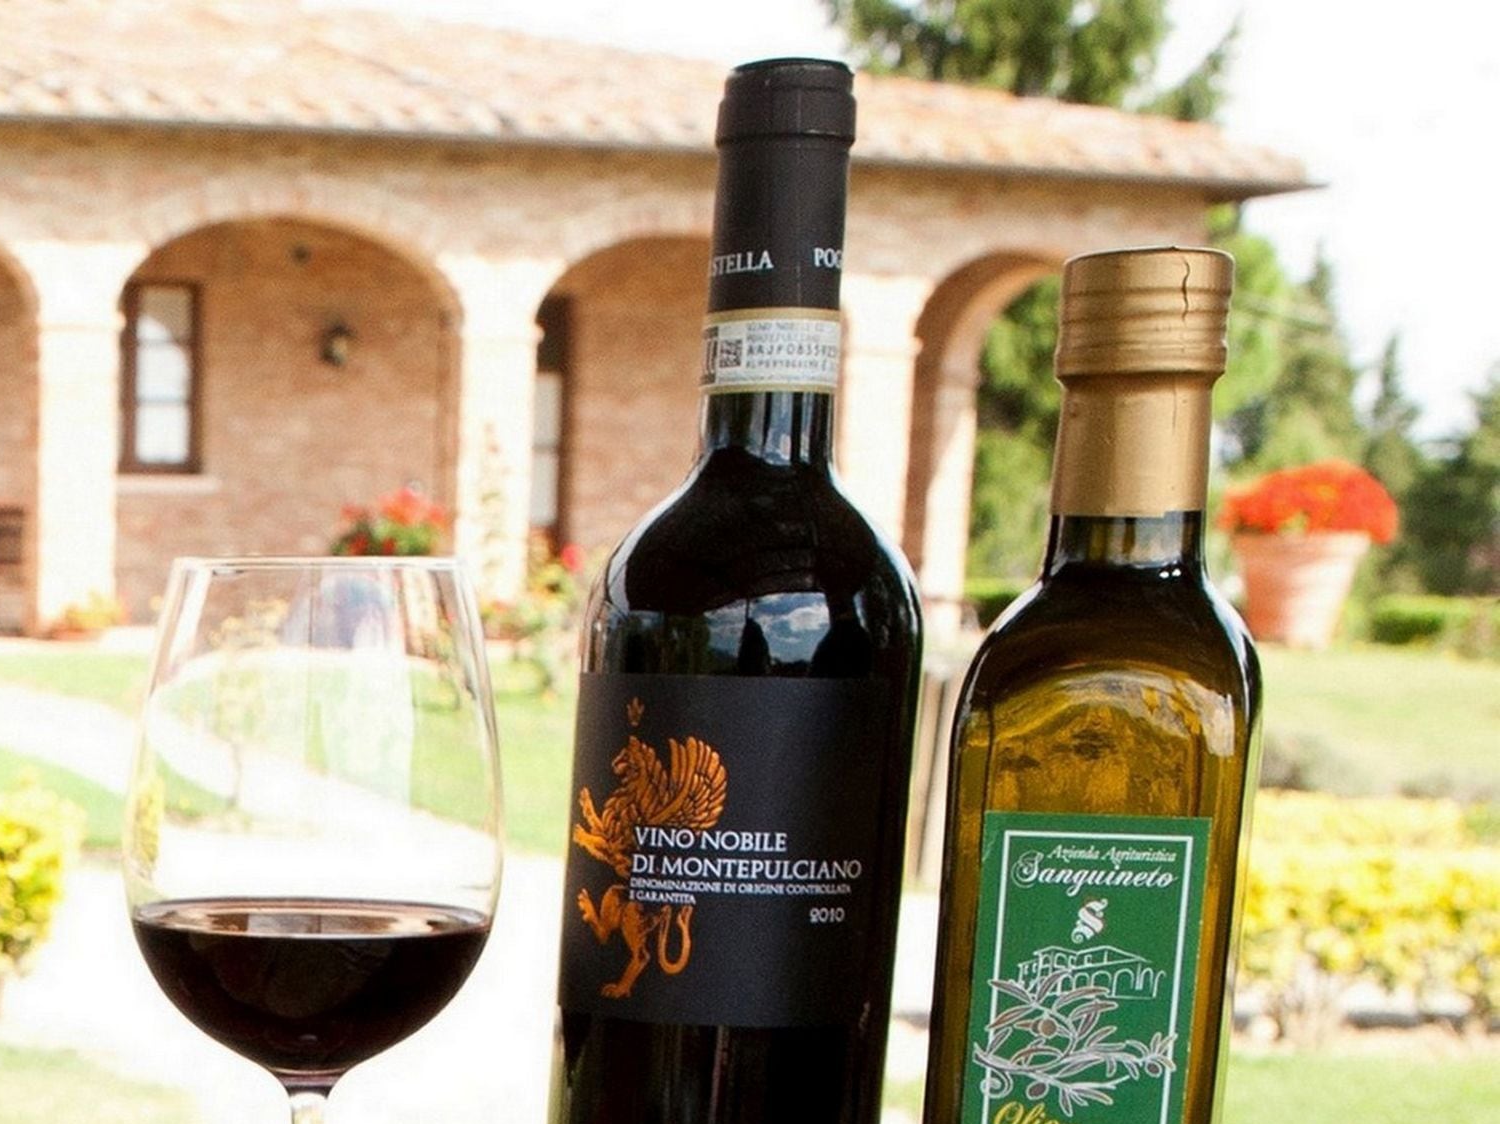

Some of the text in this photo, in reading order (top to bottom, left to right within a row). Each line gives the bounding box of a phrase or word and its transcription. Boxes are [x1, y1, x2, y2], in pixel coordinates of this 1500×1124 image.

[635, 827, 788, 851] VINO NOBILE
[1047, 844, 1100, 863] Azienda
[632, 854, 863, 880] DI MONTEPULCIANO
[1011, 850, 1179, 897] Sanguineto
[630, 877, 721, 893] DENOMINAZIONE
[723, 882, 736, 894] DI
[738, 882, 784, 895] ORIGINE
[629, 889, 696, 904] E GARANTITA
[809, 907, 845, 923] 2010
